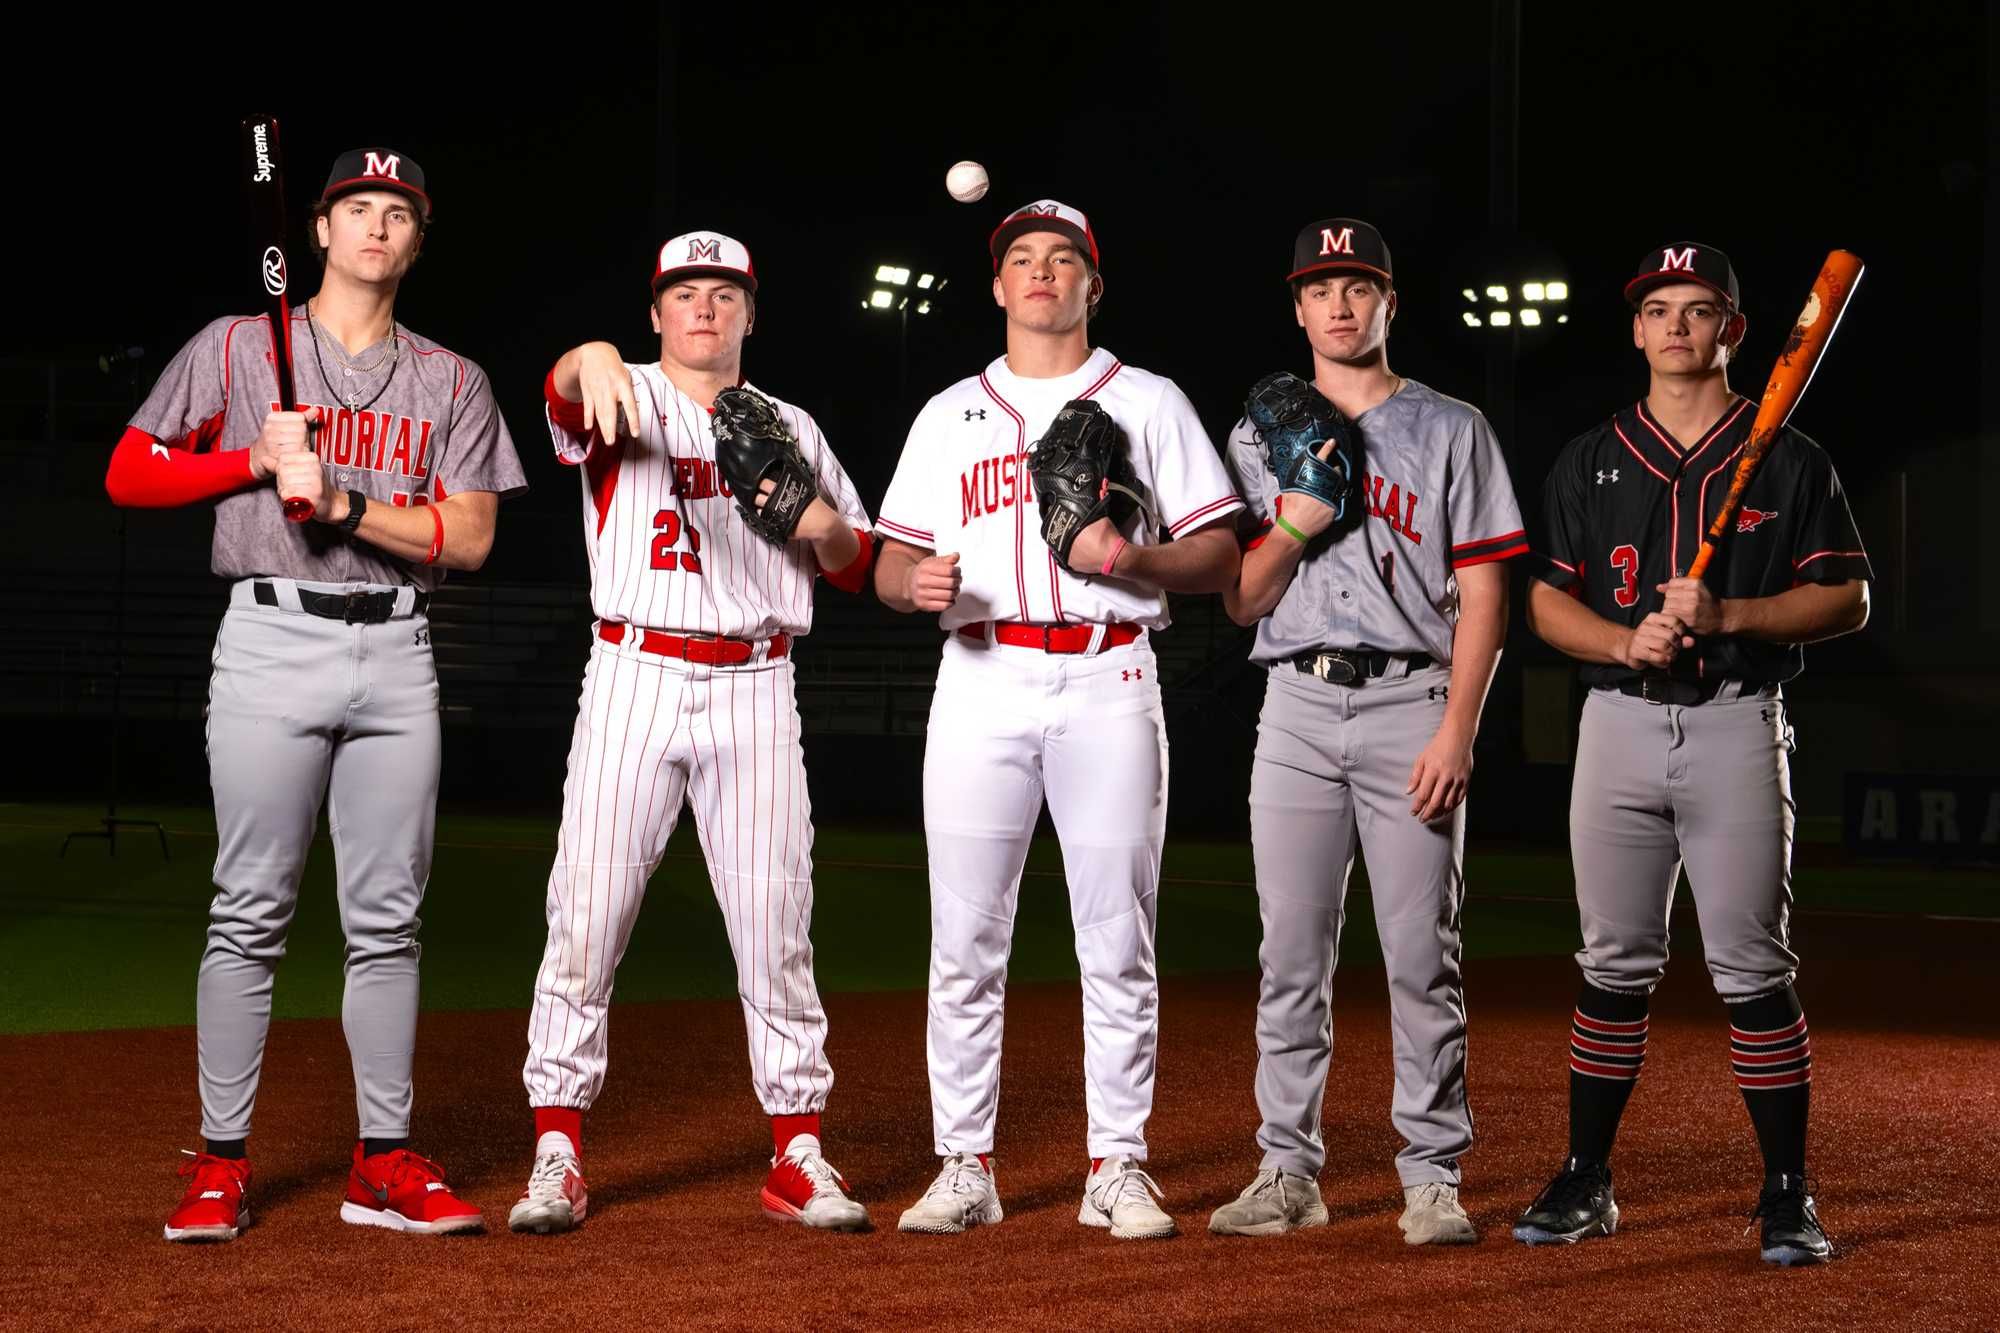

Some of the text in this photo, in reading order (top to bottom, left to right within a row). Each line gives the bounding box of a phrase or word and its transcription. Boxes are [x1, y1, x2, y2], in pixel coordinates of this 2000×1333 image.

[362, 151, 400, 181] M
[686, 238, 721, 263] M
[1318, 227, 1355, 256] M
[1658, 247, 1697, 272] M
[270, 401, 433, 479] MORIAL
[1610, 544, 1640, 608] 3
